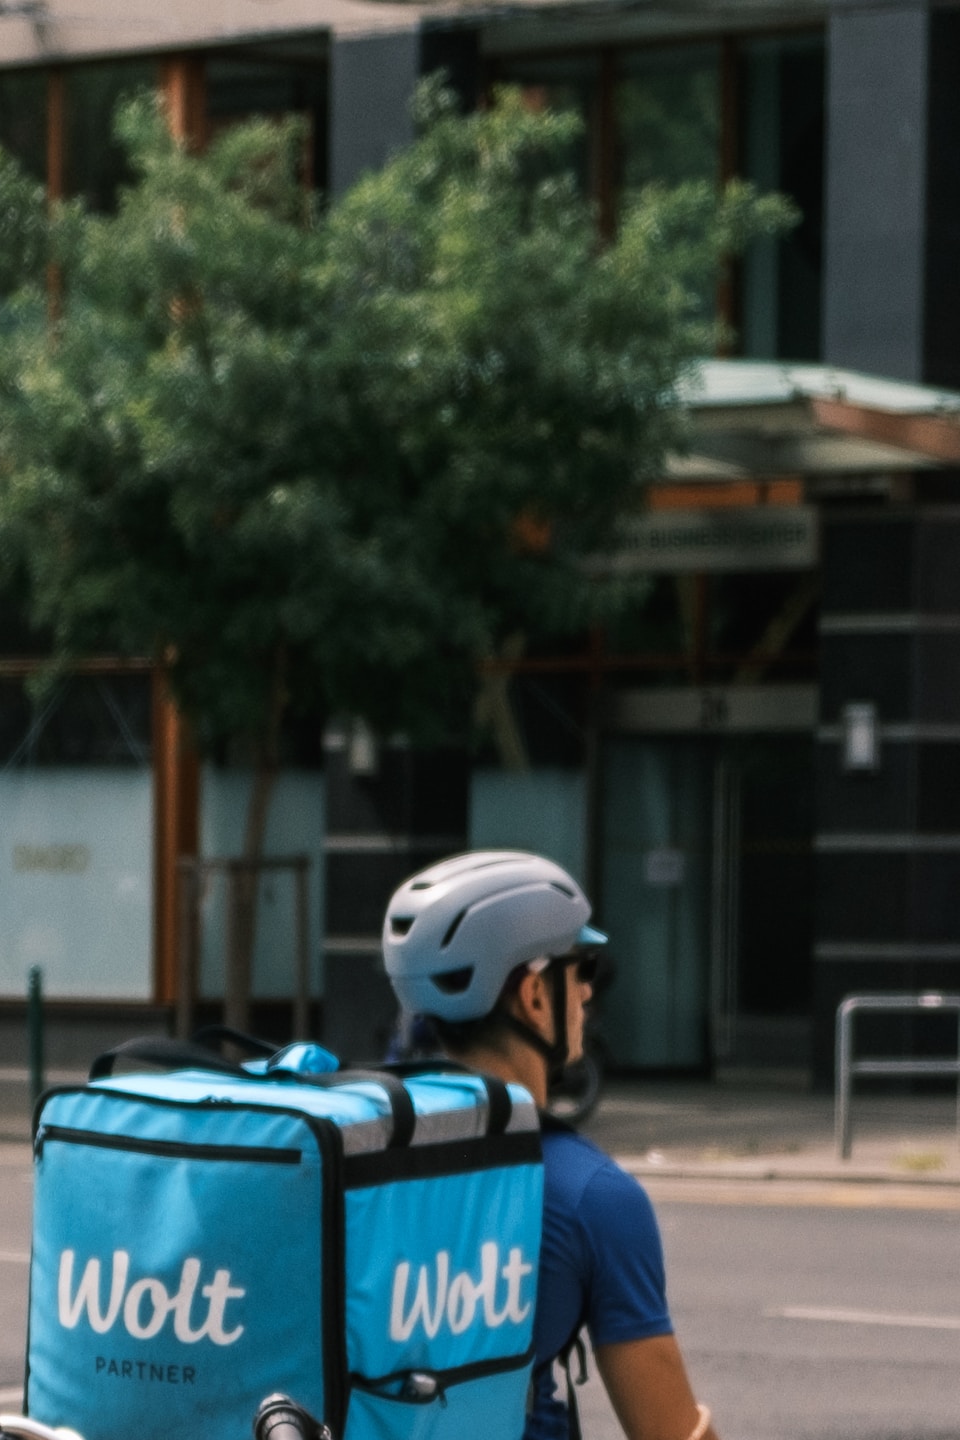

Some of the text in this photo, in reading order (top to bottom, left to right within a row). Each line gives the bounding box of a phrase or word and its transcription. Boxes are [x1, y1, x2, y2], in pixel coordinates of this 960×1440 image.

[57, 1248, 246, 1346] Wolt
[389, 1241, 533, 1342] Wolt
[94, 1355, 197, 1386] PARTNER
